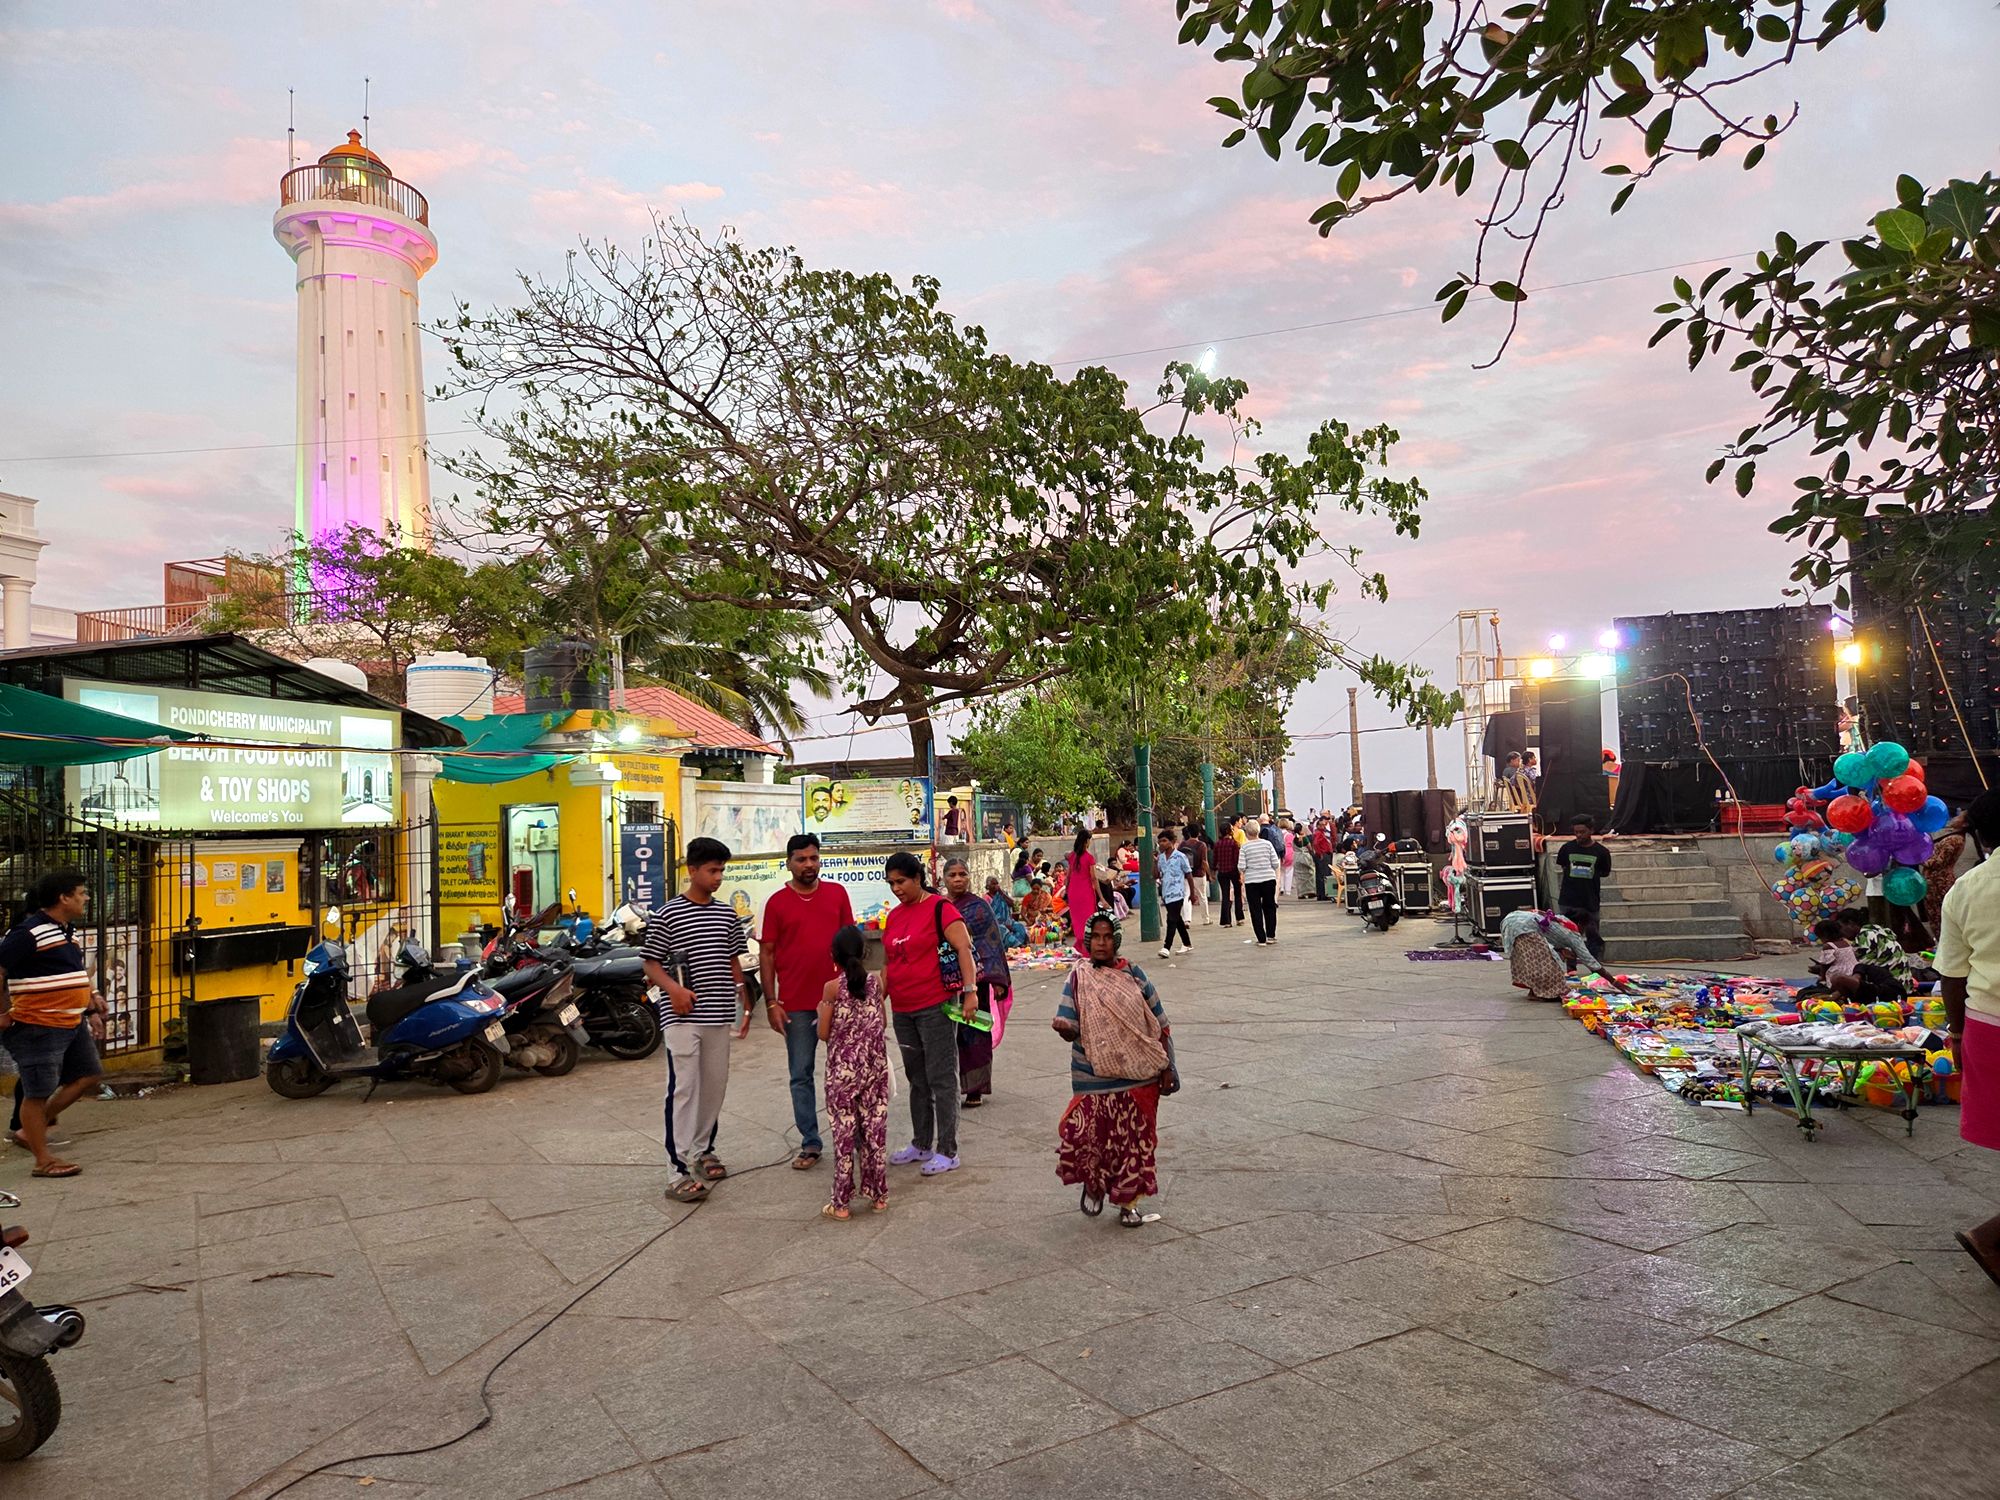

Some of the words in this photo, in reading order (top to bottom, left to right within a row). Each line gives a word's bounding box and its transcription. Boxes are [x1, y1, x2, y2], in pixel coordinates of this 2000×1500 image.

[170, 706, 257, 731] PONDICHERRY
[259, 714, 333, 736] MUNICIPALITY
[168, 738, 230, 762] BEACH
[234, 740, 279, 765] FOOD
[283, 743, 333, 767] COURT
[200, 775, 214, 802] &
[218, 776, 253, 802] TOY
[257, 778, 310, 804] SHOPS
[210, 809, 279, 823] Welcome's
[281, 809, 303, 823] You
[635, 833, 653, 910] TOILET
[838, 871, 865, 882] FOOD
